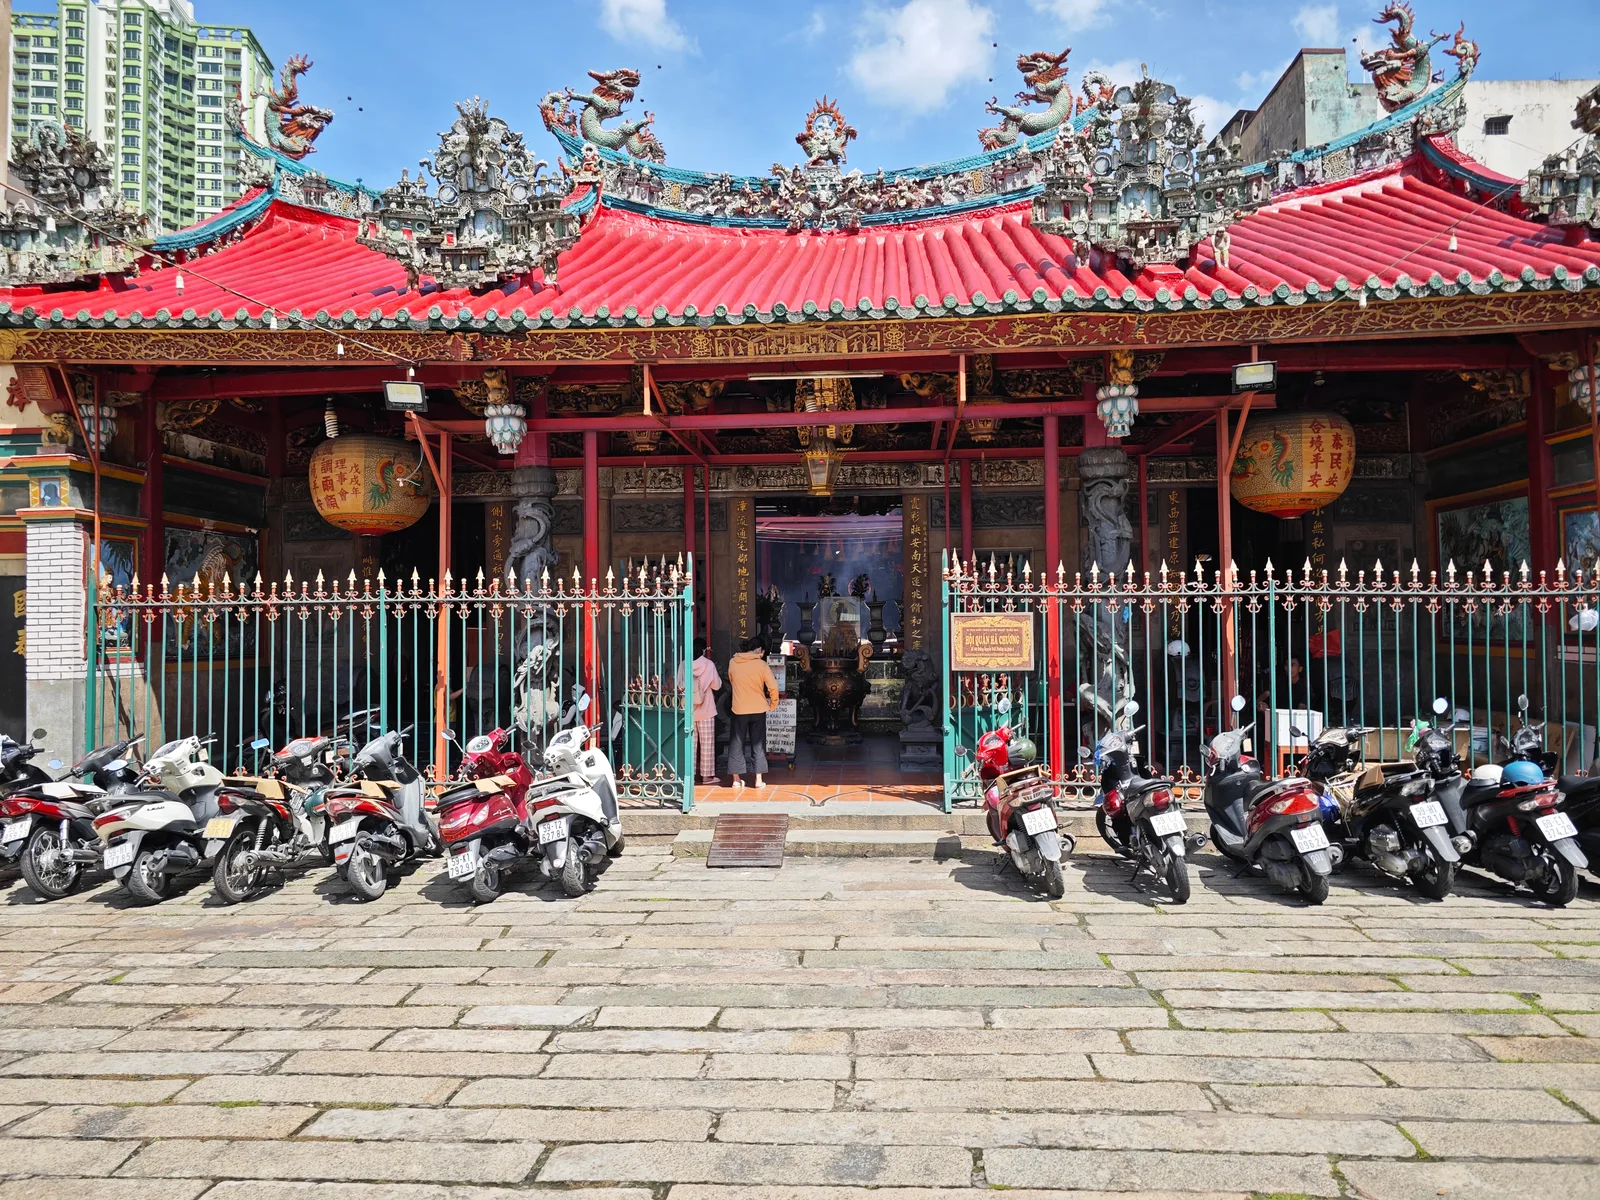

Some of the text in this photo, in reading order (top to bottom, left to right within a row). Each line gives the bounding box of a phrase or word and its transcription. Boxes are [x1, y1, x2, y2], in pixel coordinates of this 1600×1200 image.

[1307, 418, 1326, 488] 合境平安
[334, 457, 349, 501] 理事會
[349, 463, 361, 498] 戊戌年
[542, 819, 562, 832] 59-T2
[541, 828, 566, 842] 627.84
[1298, 836, 1327, 850] 096.24
[451, 853, 470, 865] 59-K1
[451, 862, 475, 876] 792.91
